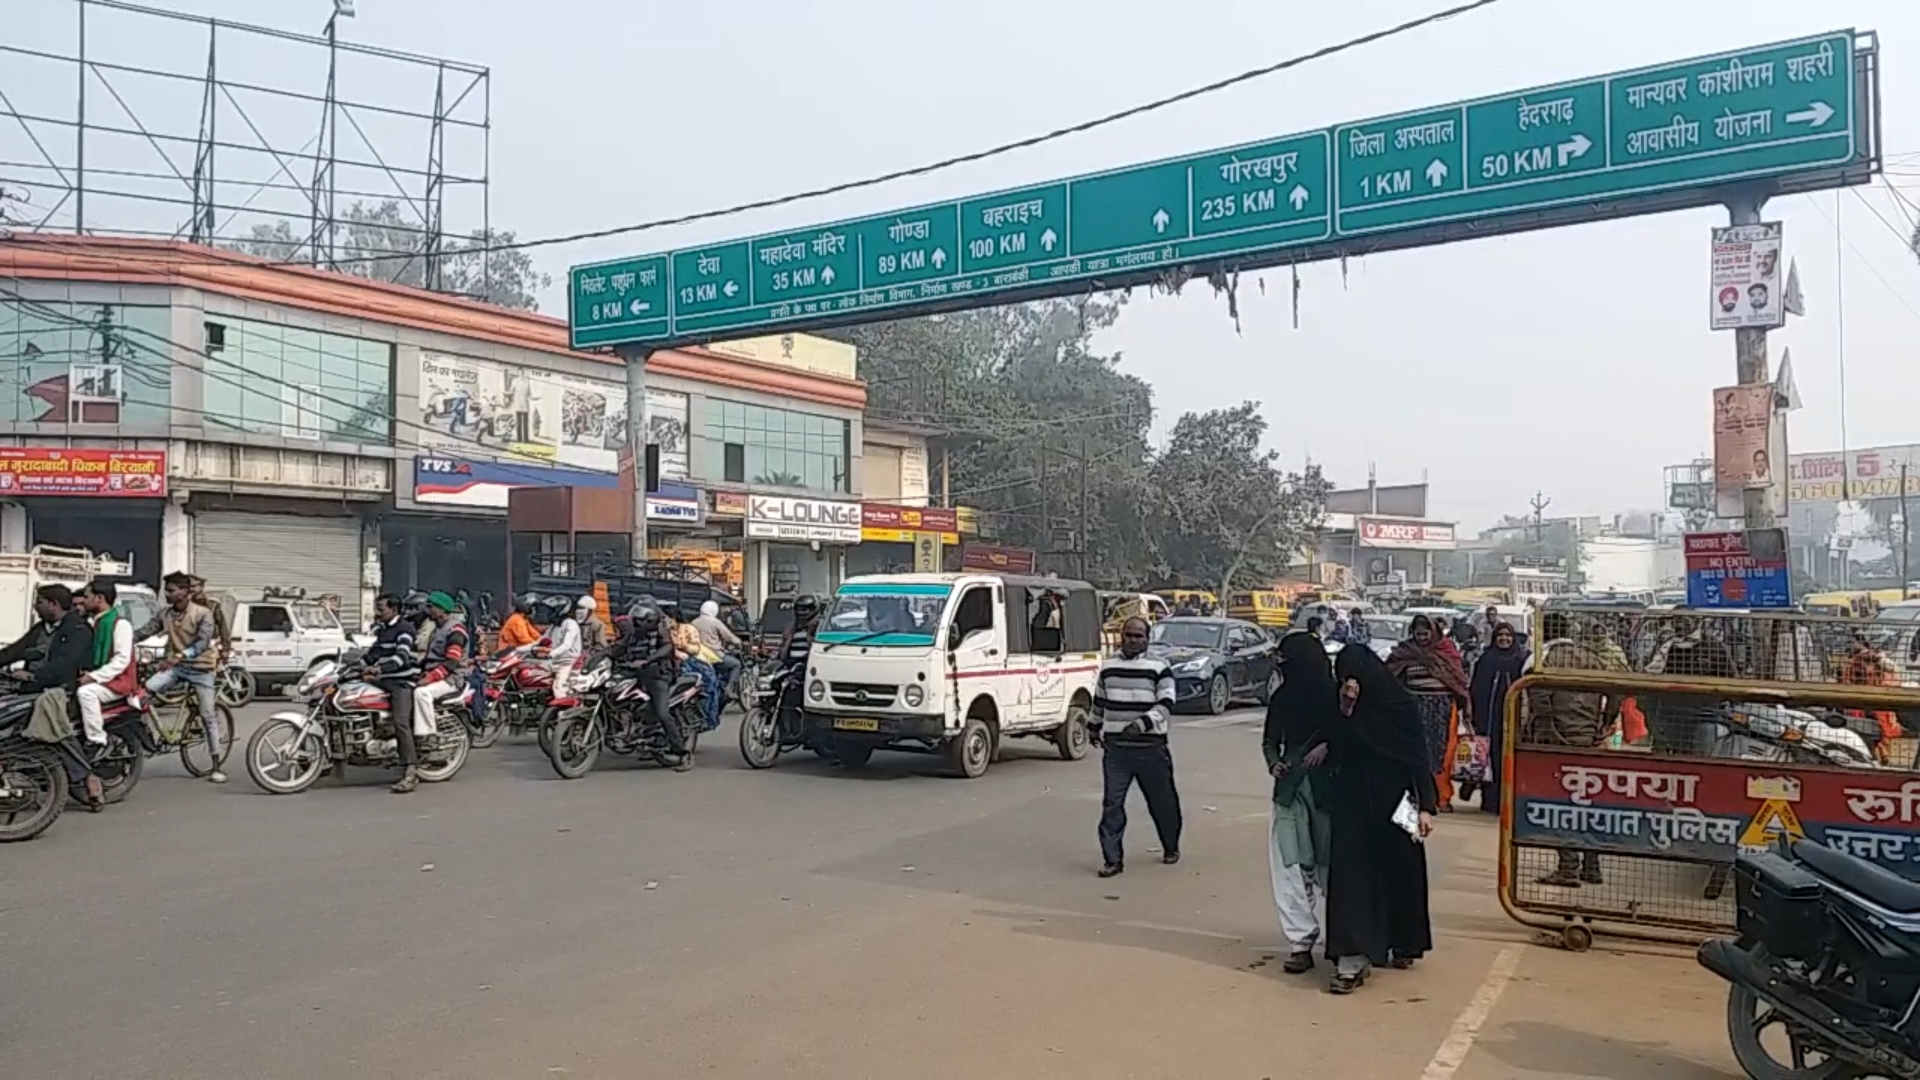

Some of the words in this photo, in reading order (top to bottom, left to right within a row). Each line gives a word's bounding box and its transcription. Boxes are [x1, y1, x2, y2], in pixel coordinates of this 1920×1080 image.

[1626, 76, 1688, 110] मान्यवर
[1697, 59, 1774, 99] कांशीराम
[1785, 42, 1835, 84] शहरी
[1517, 97, 1575, 132] हैदरगढ़
[1348, 130, 1385, 159] जिला
[1393, 119, 1455, 151] अस्पताल
[1626, 115, 1699, 156] आवासीय
[1714, 105, 1772, 141] योजना
[1219, 151, 1298, 184] गोरखपुर
[1481, 153, 1510, 179] 50
[1514, 145, 1552, 175] KM
[1360, 177, 1369, 198] 1
[1376, 170, 1412, 196] KM
[982, 199, 1043, 228] बहराइच
[1201, 195, 1235, 221] 235
[1243, 188, 1275, 214] KM
[888, 219, 930, 244] गोण्डा
[759, 238, 806, 267] महादेवा
[812, 232, 846, 258] मंदिर
[968, 238, 994, 259] 100
[1000, 232, 1026, 255] KM
[698, 252, 721, 276] देवा
[878, 254, 896, 275] 89
[901, 249, 926, 271] KM
[1049, 259, 1081, 277] आपकी
[1087, 257, 1109, 271] यात्रा
[772, 272, 790, 291] 35
[792, 267, 816, 287] KM
[680, 287, 694, 305] 13
[697, 281, 718, 302] KM
[592, 304, 600, 321] 8
[603, 300, 622, 319] KM
[110, 458, 156, 474] बिरयानी
[421, 458, 452, 472] TVS
[751, 497, 860, 525] K-LOUNGE
[1378, 524, 1419, 539] MRF
[1709, 557, 1724, 568] NO
[1725, 556, 1758, 568] ENTRY
[1370, 572, 1385, 583] LG
[1560, 764, 1700, 804] कृपया
[1525, 800, 1641, 836] यातायात
[1646, 806, 1741, 848] पुलिस
